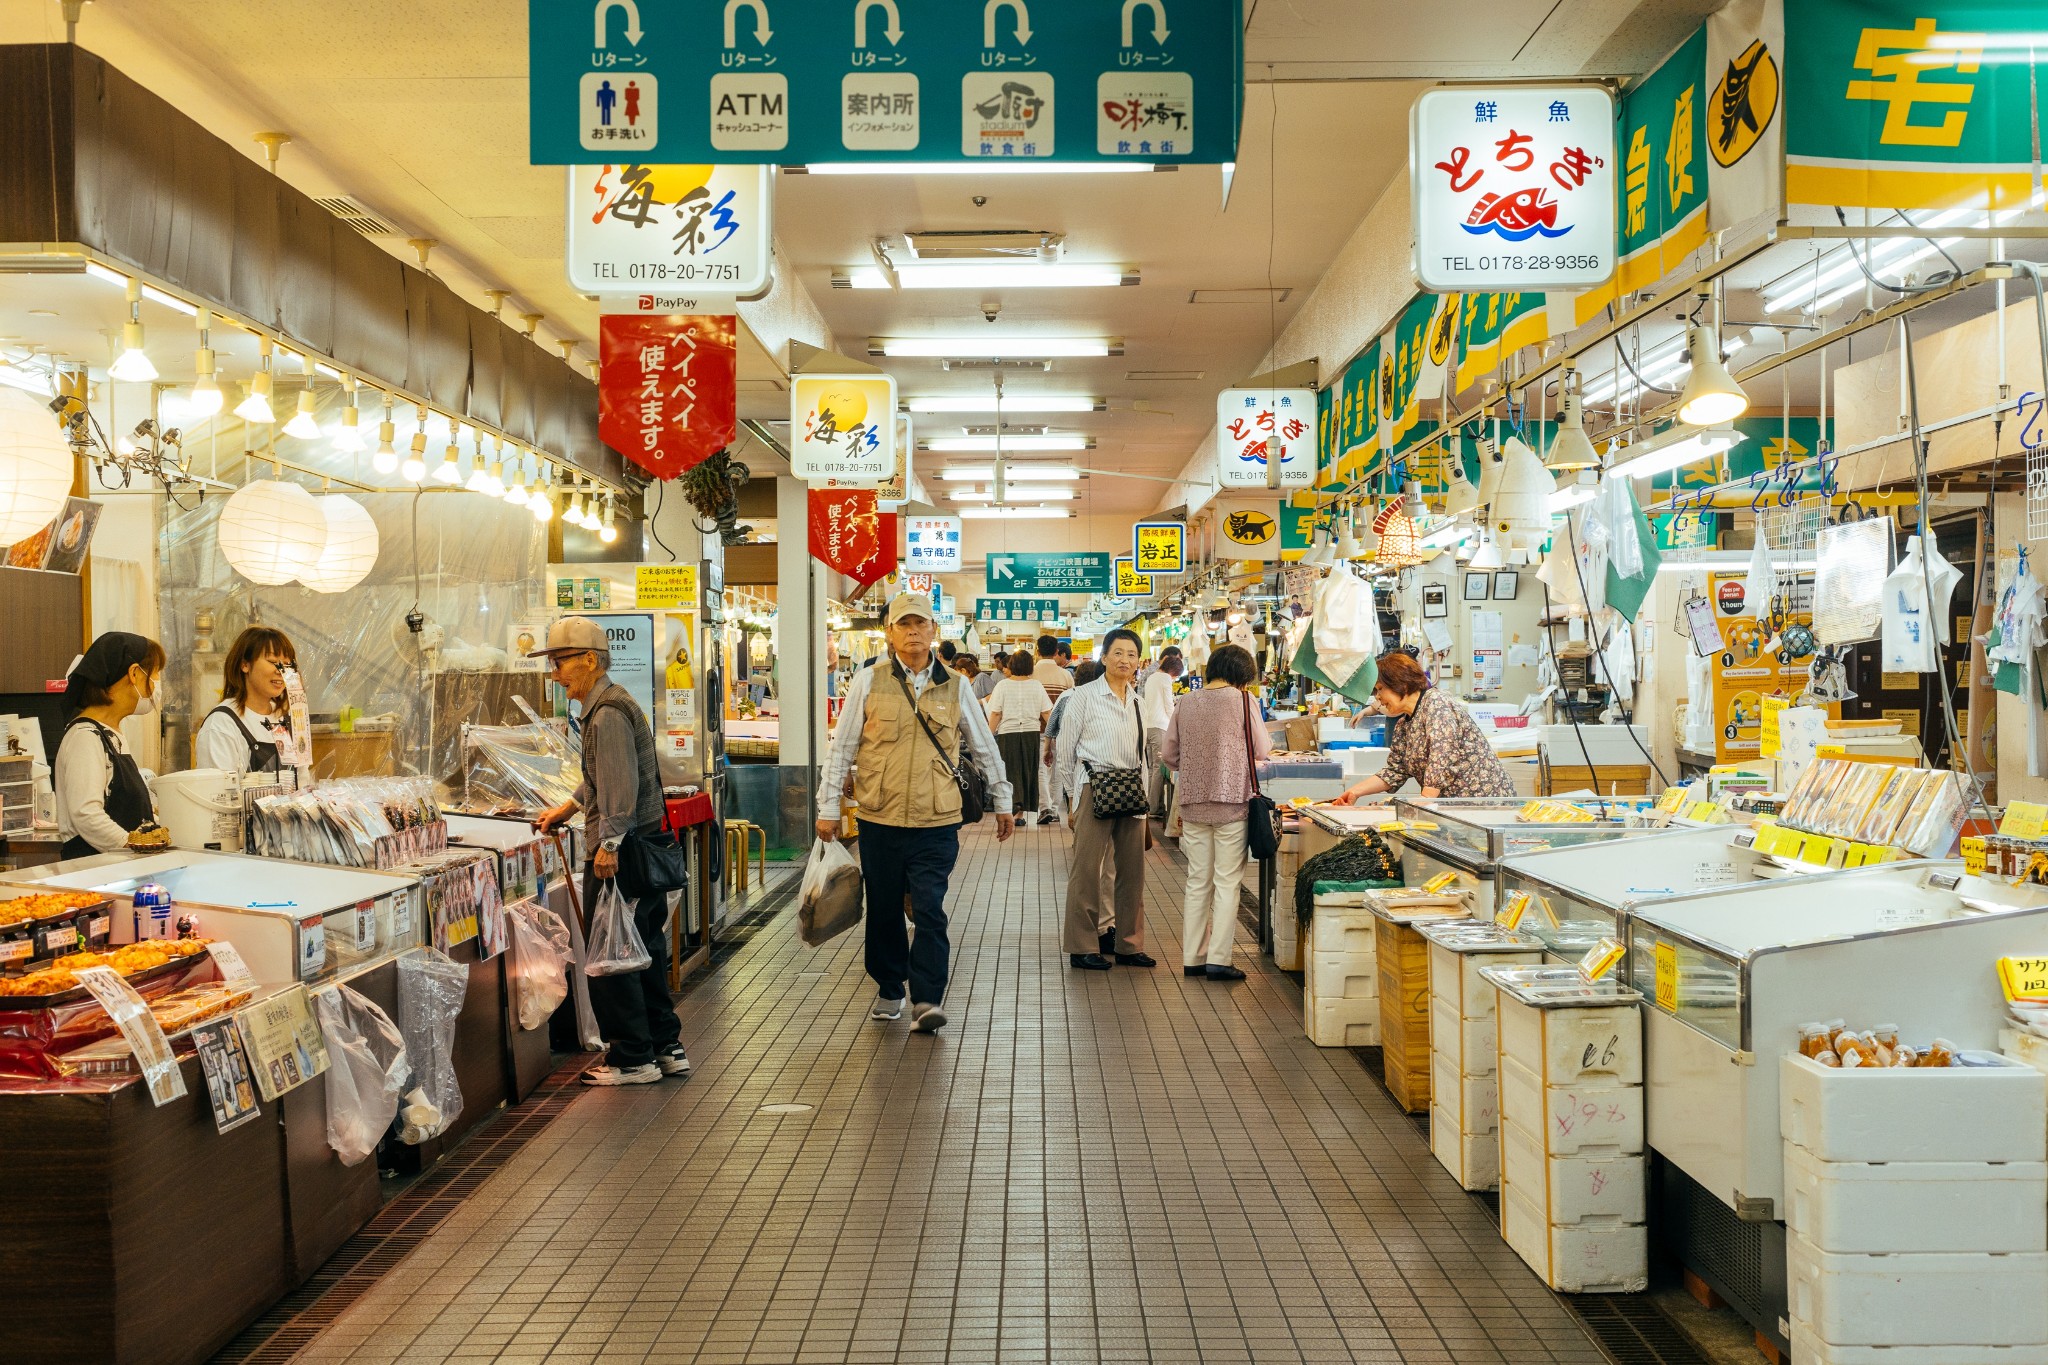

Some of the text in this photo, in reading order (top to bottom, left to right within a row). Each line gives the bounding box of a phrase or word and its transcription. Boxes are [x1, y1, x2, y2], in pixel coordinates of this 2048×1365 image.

[592, 53, 647, 67] Uターン
[722, 53, 777, 67] Uターン
[852, 52, 907, 67] Uターン
[981, 52, 1036, 67] Uターン
[1119, 52, 1174, 66] Uターン
[1846, 18, 1987, 147] 宅
[716, 94, 783, 115] ATM
[847, 93, 914, 116] 案内所
[1474, 100, 1571, 123] 鮮魚
[716, 122, 783, 133] キャッシュコーナー
[847, 122, 914, 133] インフォメーション
[980, 121, 1025, 130] stadium
[591, 128, 646, 140] お手洗い
[980, 142, 1035, 155] 飲食街
[1118, 140, 1173, 153] 飲食街
[1443, 256, 1599, 271] TEL 0178-28-9356
[593, 262, 740, 280] TEL 0178-20-7751
[656, 297, 698, 310] PayPay
[671, 327, 697, 428] ペイペイ
[638, 345, 666, 460] 使えます。
[1244, 396, 1292, 408] 鮮魚
[804, 407, 880, 458] 海彩
[806, 462, 882, 472] TEL 0178-20-7751
[1229, 471, 1245, 480] TEL
[836, 479, 859, 487] PayPay
[844, 494, 858, 547] ペイペイ
[827, 504, 842, 564] 使えます。
[1142, 528, 1177, 538] 高級鮮魚
[911, 547, 956, 558] 島守商店
[1140, 542, 1179, 560] 岩正
[1036, 557, 1099, 566] チビッコ映画劇場
[1013, 580, 1028, 588] 2F
[1037, 578, 1092, 587] 屋内ゆうえんち
[1781, 651, 1789, 664] 2
[1727, 727, 1735, 738] 3
[2015, 959, 2048, 973] サク
